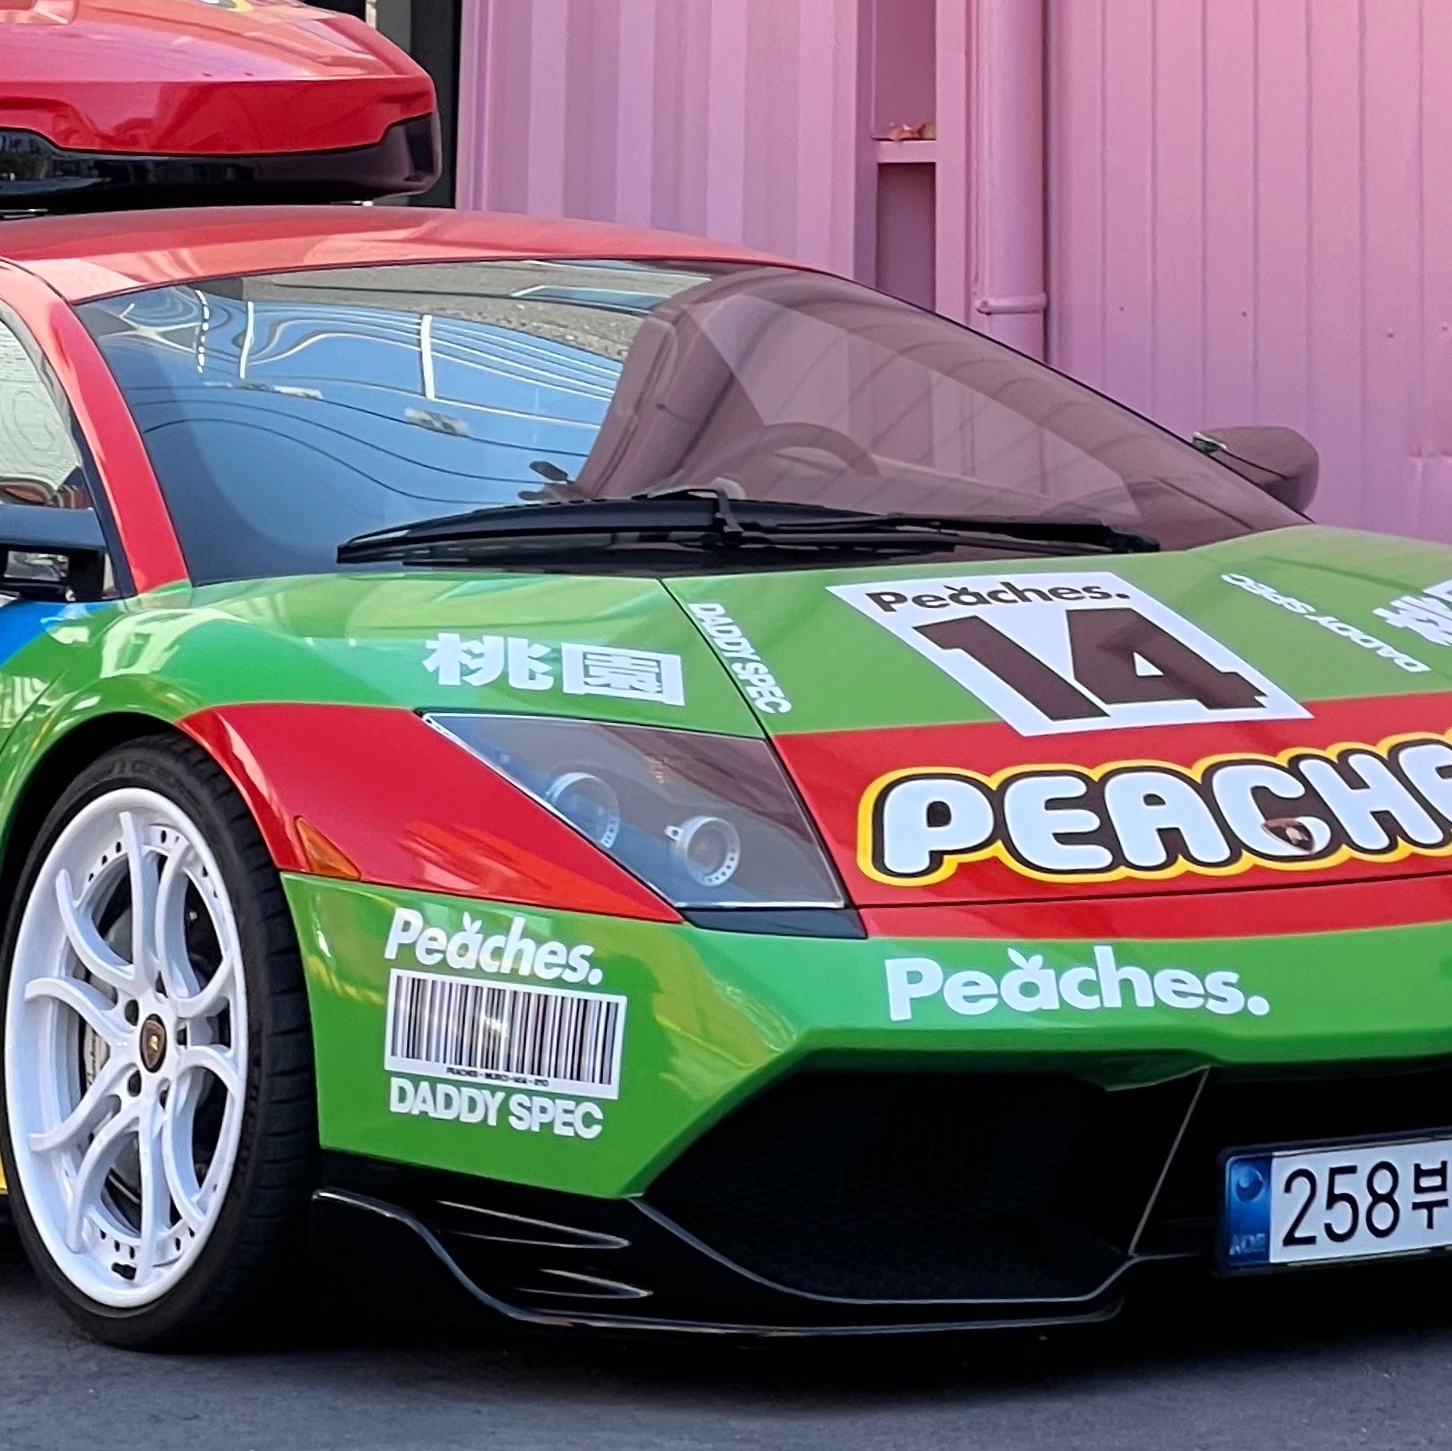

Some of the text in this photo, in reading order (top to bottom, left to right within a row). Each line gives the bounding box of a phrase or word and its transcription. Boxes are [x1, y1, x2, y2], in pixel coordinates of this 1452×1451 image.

[422, 632, 685, 706] 桃園
[688, 602, 792, 714] DADDY SPEC
[912, 607, 1268, 722] 14
[389, 1077, 604, 1140] DADDY SPEC
[1282, 1160, 1449, 1247] 258부
